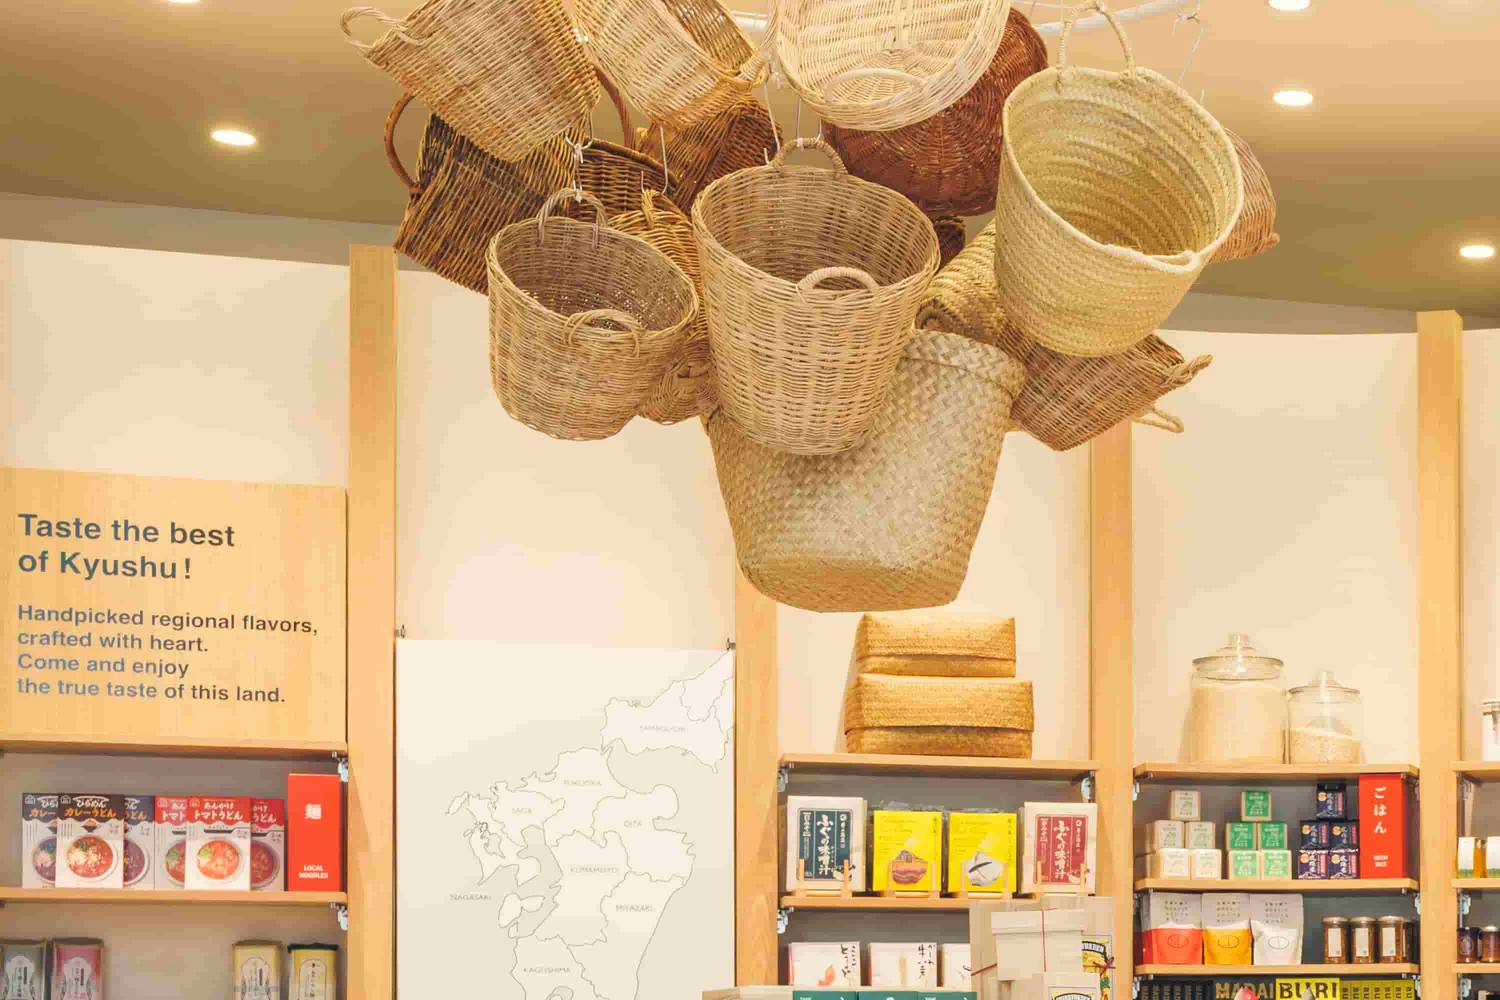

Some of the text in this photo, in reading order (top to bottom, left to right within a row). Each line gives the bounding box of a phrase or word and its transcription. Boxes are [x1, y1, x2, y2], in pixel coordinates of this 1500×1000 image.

[18, 513, 235, 546] Taste the best
[18, 550, 49, 573] of
[18, 604, 318, 636] Handpicked regional flavors,
[18, 630, 208, 652] crafted with heart.
[18, 653, 189, 678] Come and enjoy
[17, 679, 286, 703] the true taste of this land.
[64, 808, 117, 818] カレーうどん
[194, 810, 243, 821] トマトうどん
[1374, 786, 1387, 834] ごはん
